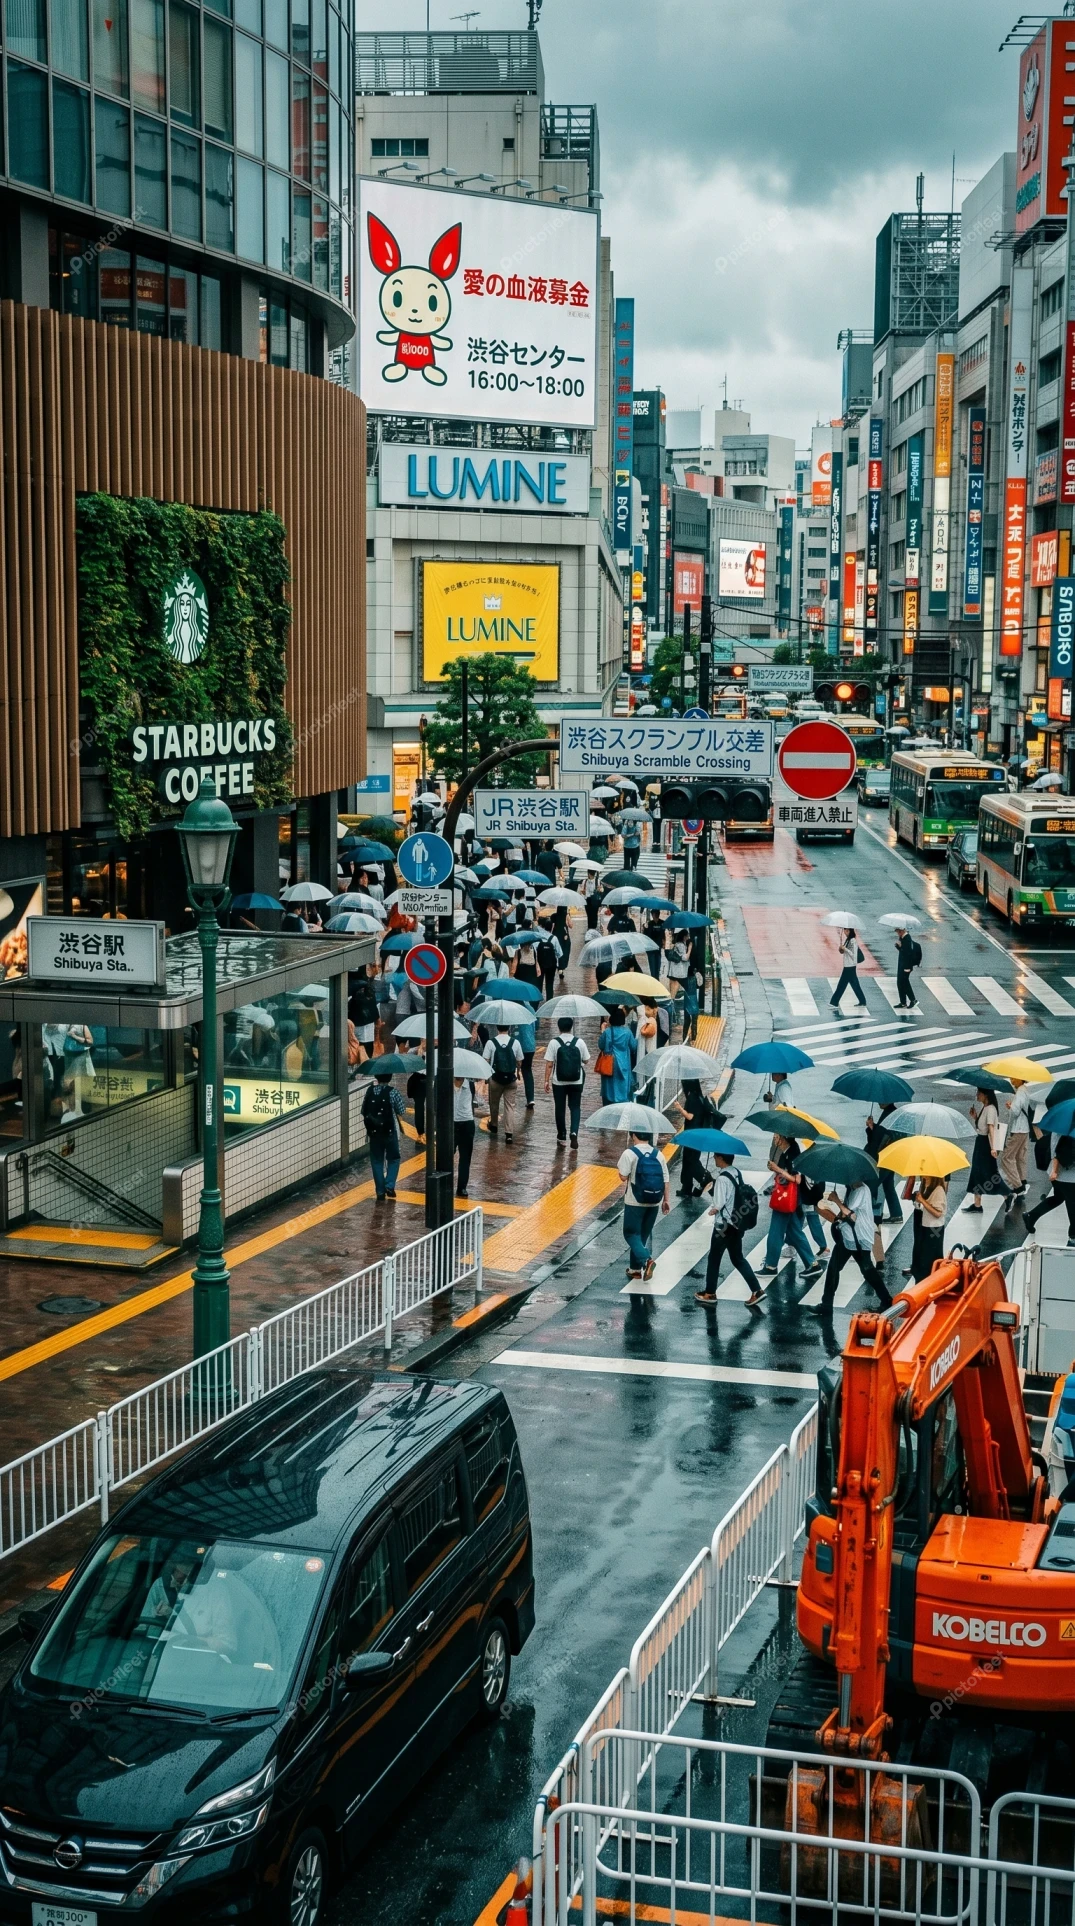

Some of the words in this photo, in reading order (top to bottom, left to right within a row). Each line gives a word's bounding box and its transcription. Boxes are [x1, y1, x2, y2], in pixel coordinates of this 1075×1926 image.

[463, 268, 590, 308] 愛の血液募金
[466, 337, 586, 369] 渋谷センター
[408, 453, 567, 504] LUMINE
[447, 616, 537, 642] LUMINE
[132, 718, 276, 762] STARBUCKS
[567, 726, 765, 754] 渋谷スクランブル交差
[581, 753, 629, 768] Shibuya
[634, 753, 691, 768] Scramble
[696, 755, 751, 771] Crossing
[485, 820, 501, 831] JR
[506, 820, 550, 833] Shibuya
[555, 821, 578, 832] Sta.
[778, 806, 853, 824] 車両進入禁止
[59, 932, 125, 957] 渋谷駅
[54, 956, 103, 972] Shibuya
[255, 1088, 300, 1107] 渋谷駅
[929, 1334, 960, 1391] KOBELCO
[932, 1612, 1047, 1648] KOBELCO
